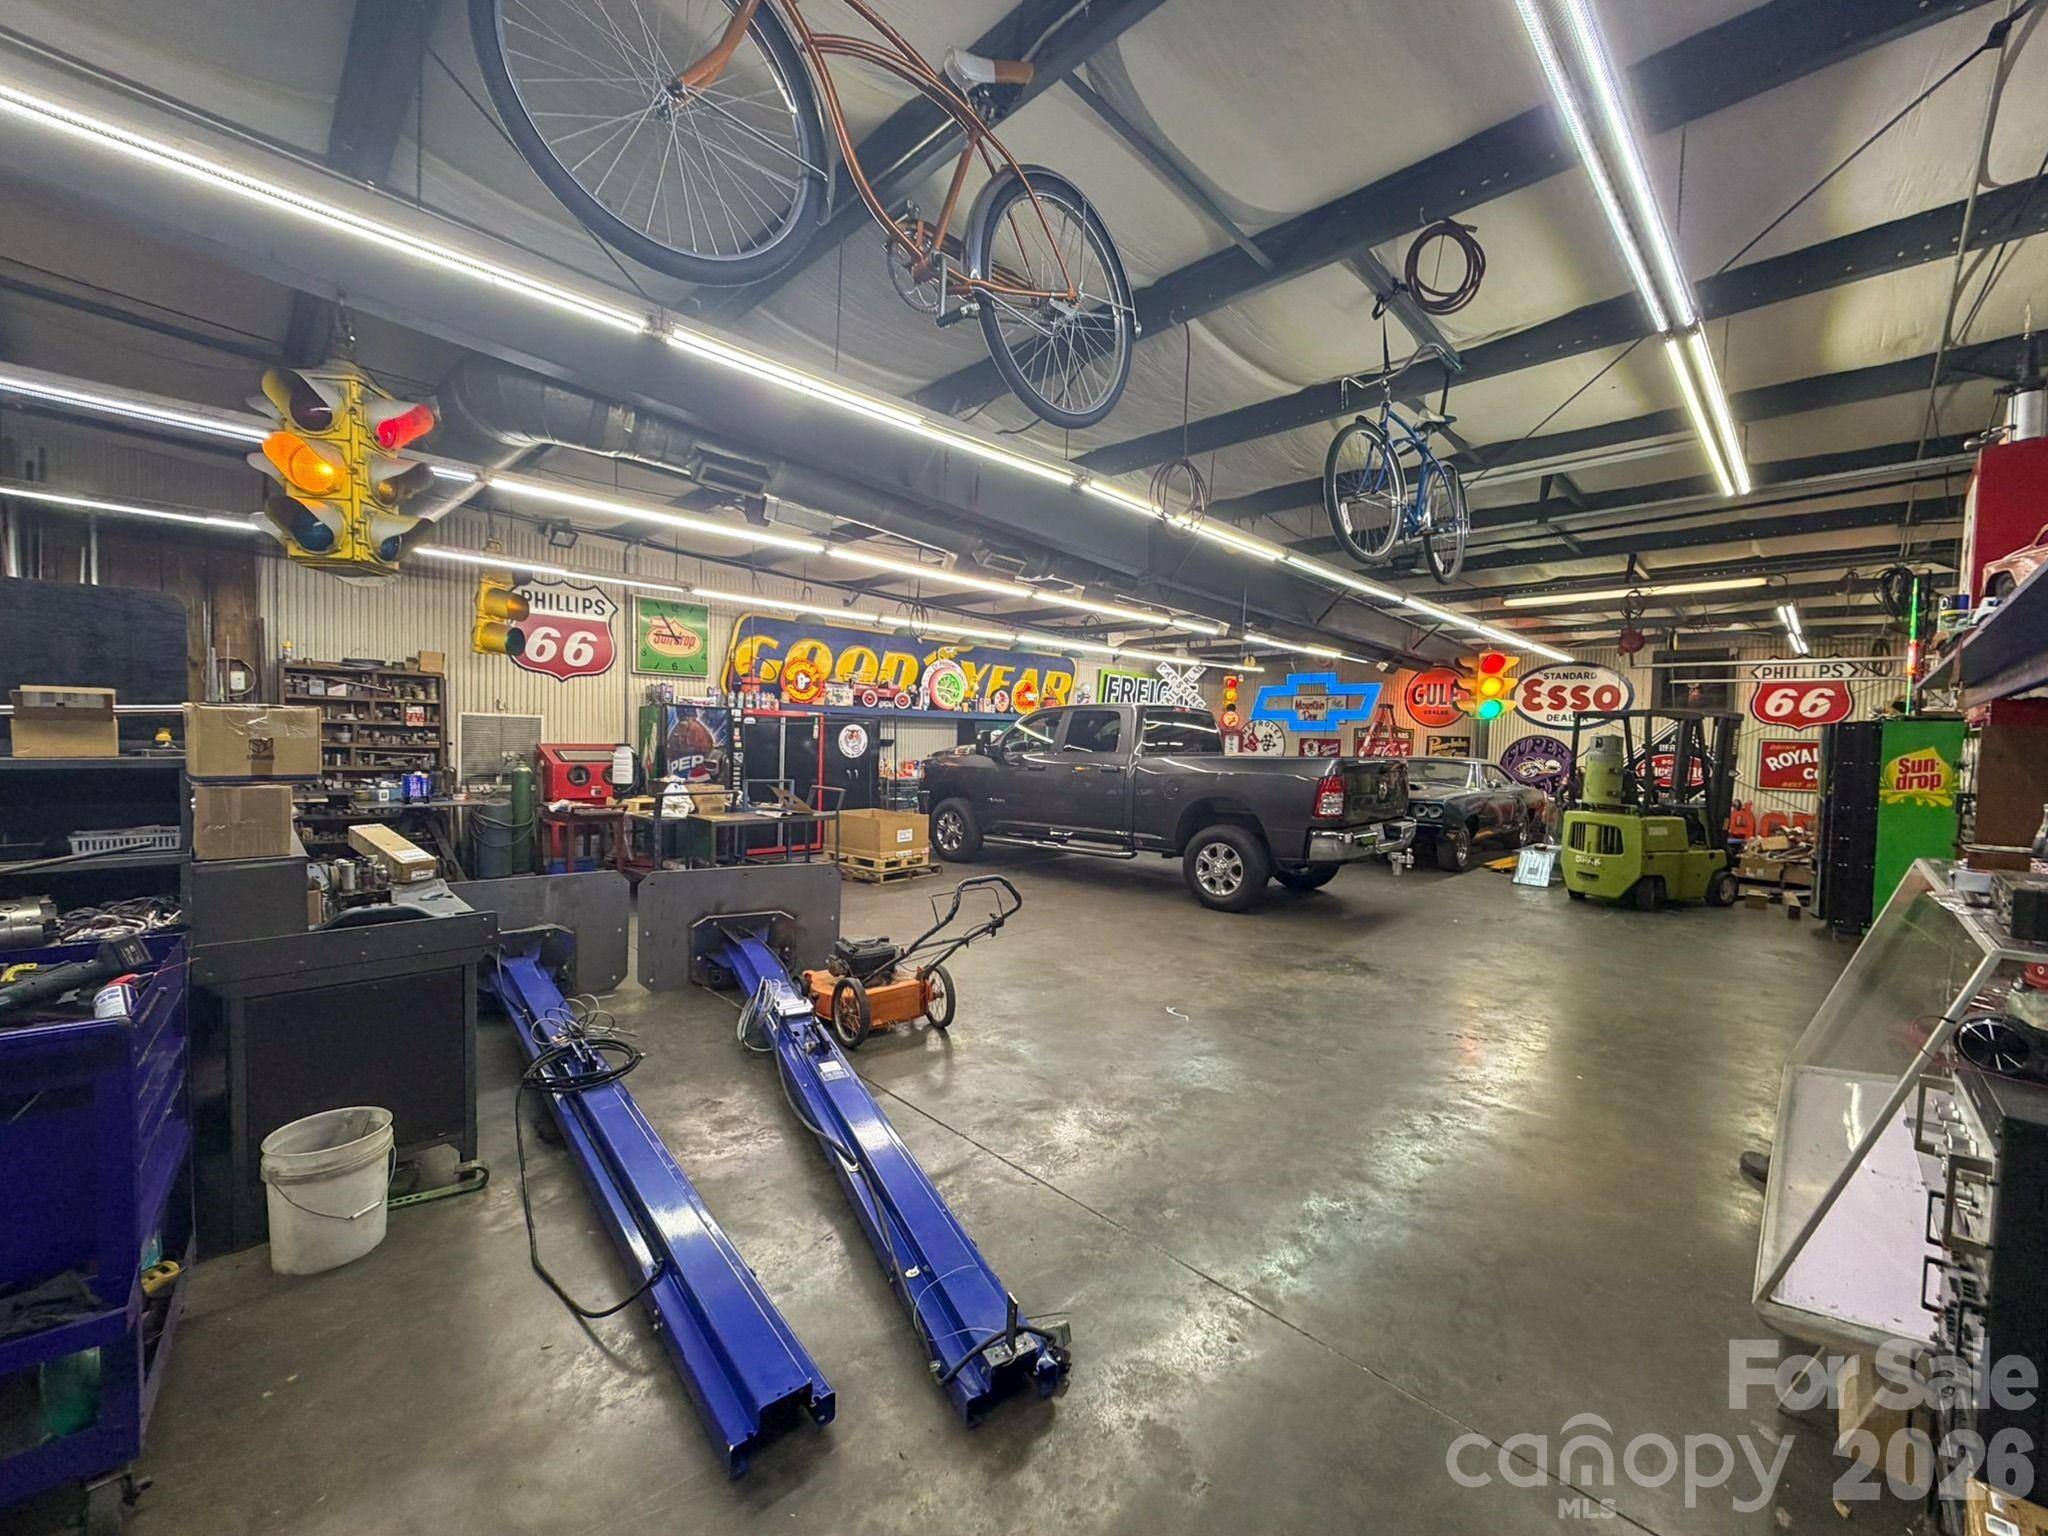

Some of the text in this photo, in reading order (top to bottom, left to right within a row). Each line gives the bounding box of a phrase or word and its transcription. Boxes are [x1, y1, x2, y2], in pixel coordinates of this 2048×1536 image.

[520, 588, 606, 616] PHILLIPS
[525, 626, 599, 667] 66
[1762, 663, 1845, 680] PHILLIPS
[1521, 678, 1622, 712] ESSO
[1764, 687, 1836, 718] 66
[1546, 713, 1590, 723] DEALR
[671, 755, 705, 773] PEP
[1504, 739, 1571, 773] SUPER
[1895, 774, 1942, 792] drop
